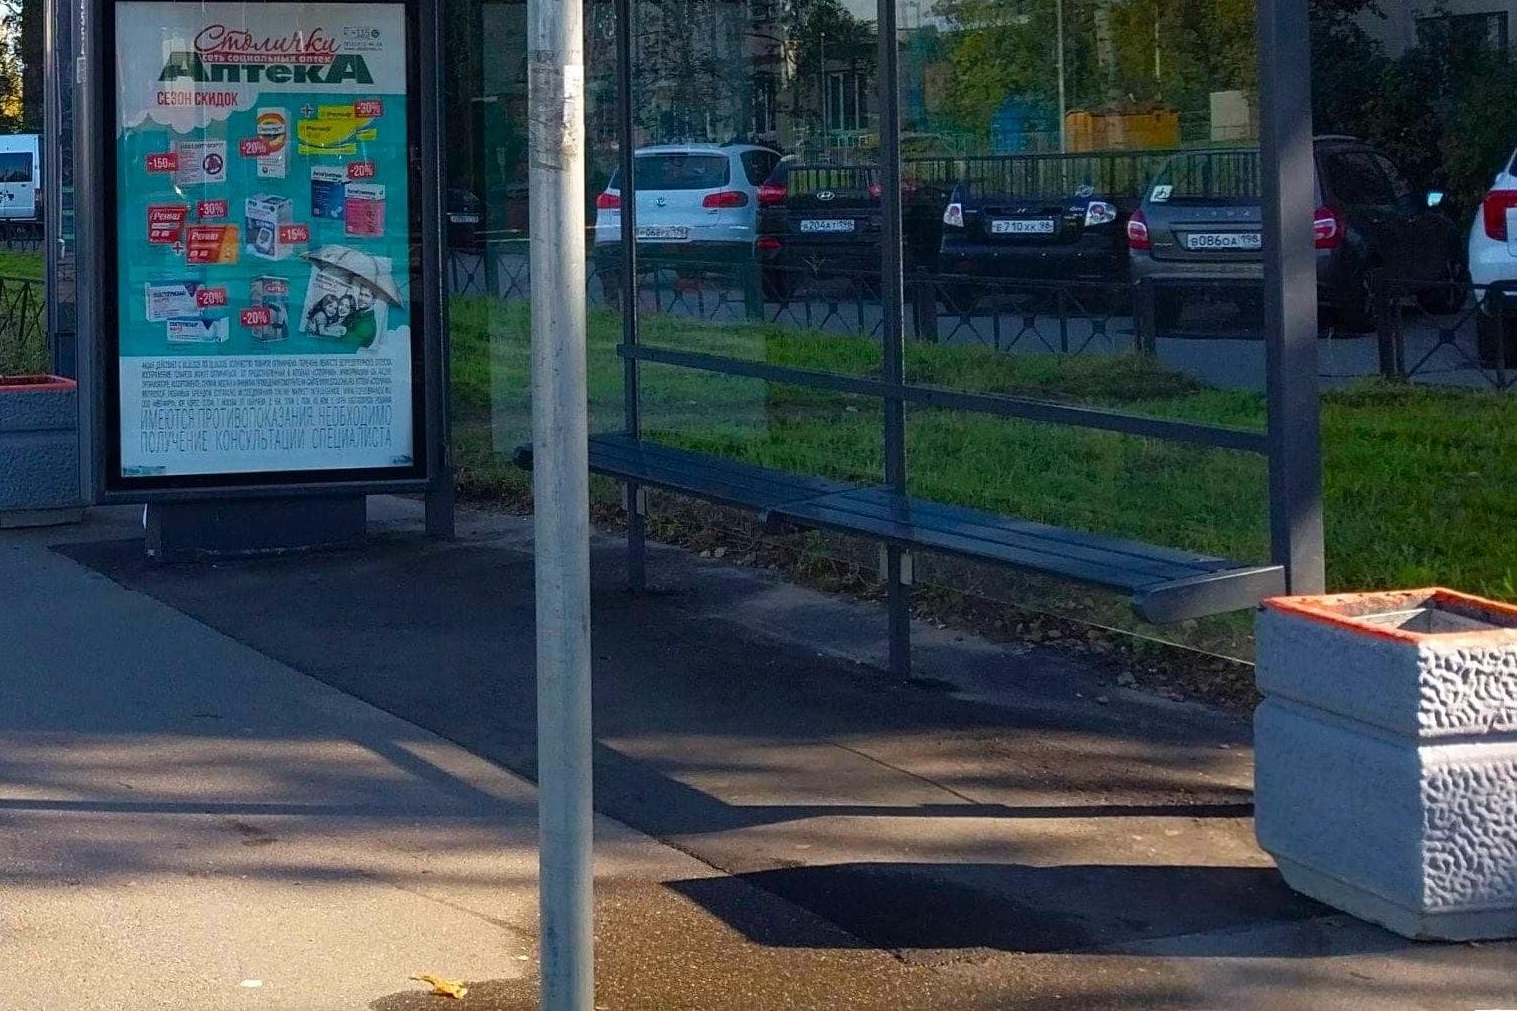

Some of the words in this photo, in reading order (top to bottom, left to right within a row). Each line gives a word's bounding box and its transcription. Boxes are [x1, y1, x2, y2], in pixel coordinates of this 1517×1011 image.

[194, 24, 342, 53] Столички
[157, 91, 192, 106] СЕЗОН
[194, 91, 238, 107] СКИДОК
[356, 102, 382, 113] -30%
[350, 164, 374, 177] -20%
[199, 202, 224, 215] -30%
[282, 228, 307, 240] -15%
[199, 291, 224, 304] -20%
[242, 311, 268, 324] -20%
[141, 408, 194, 430] ИМЕЮТСЯ
[319, 405, 392, 427] НЕОБХОДИМО
[141, 430, 208, 453] ПОЛУЧЕНИЕ
[216, 428, 305, 451] КОНСУЛЬТАЦИИ
[312, 427, 392, 449] СПЕЦИАЛИСТА
